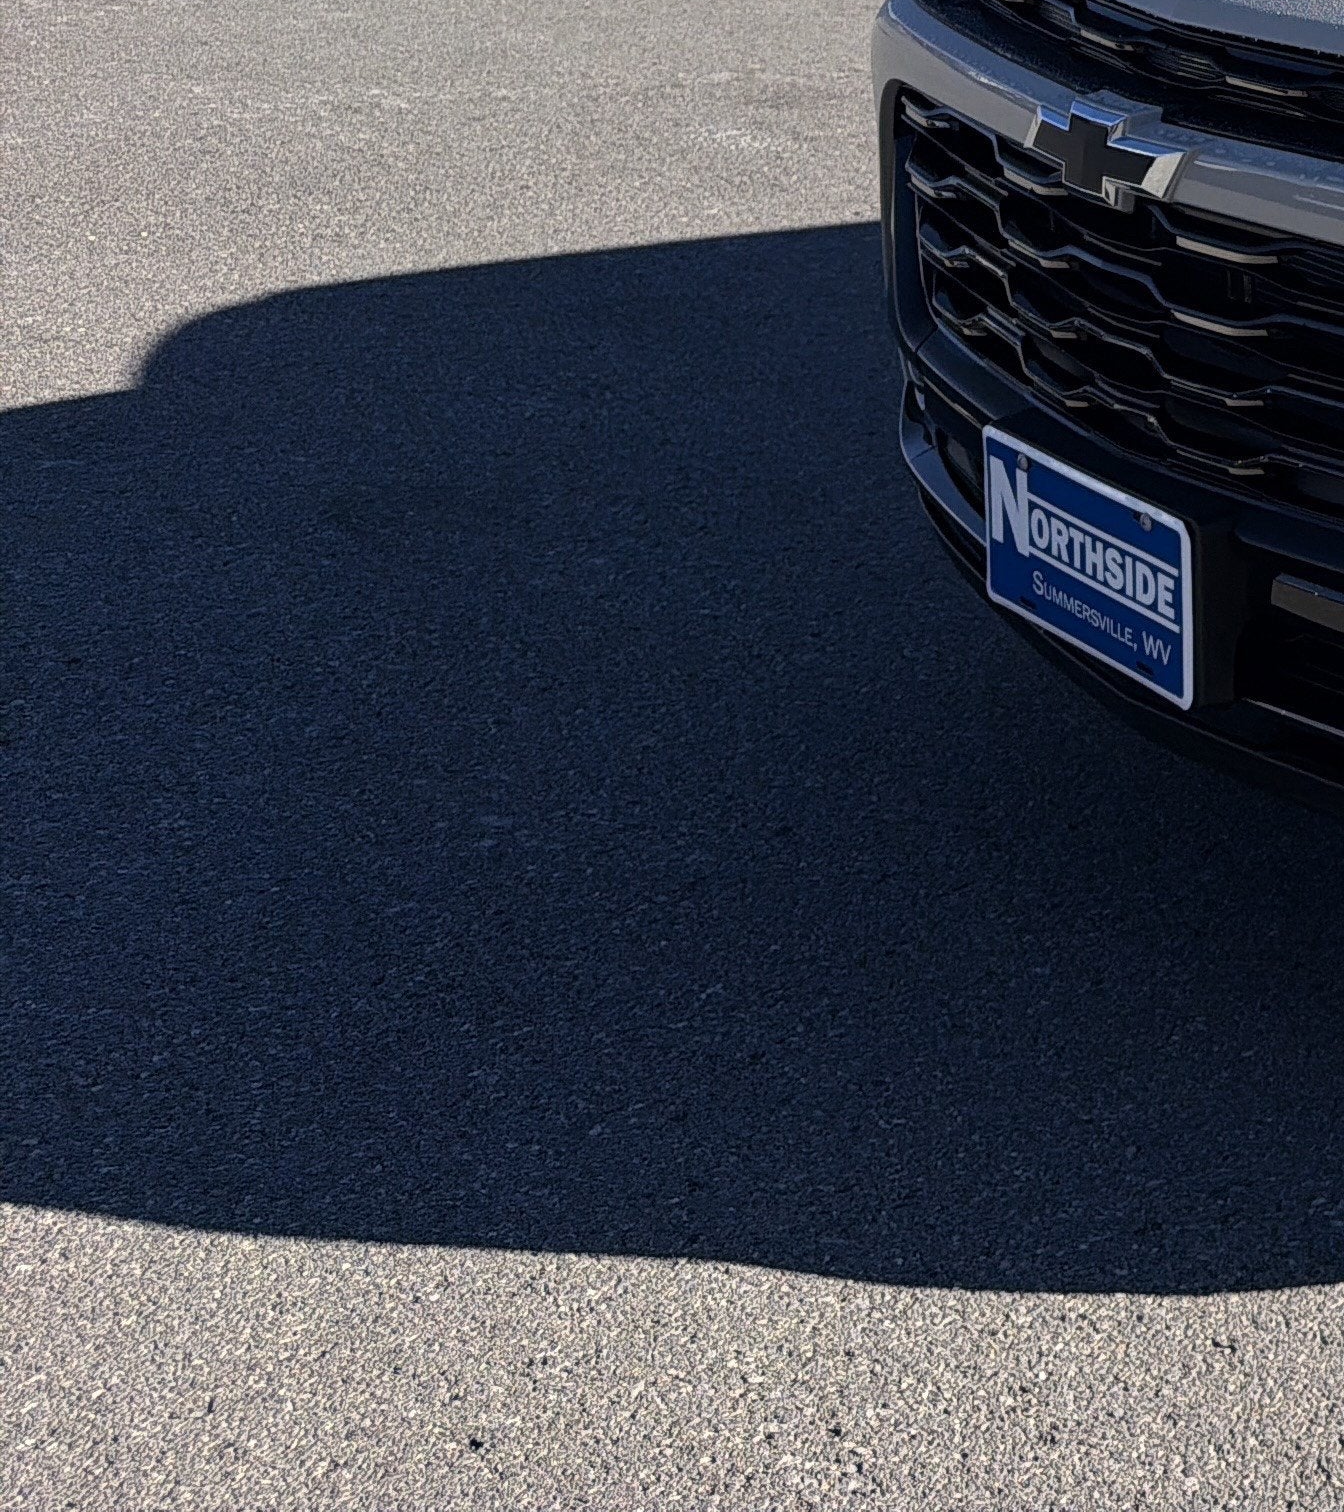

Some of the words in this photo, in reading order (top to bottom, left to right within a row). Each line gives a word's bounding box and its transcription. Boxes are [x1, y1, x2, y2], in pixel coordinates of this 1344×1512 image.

[989, 454, 1176, 621] NORTHSIDE
[1032, 570, 1138, 653] SUMMERSVILLE,
[1142, 630, 1172, 666] WV
